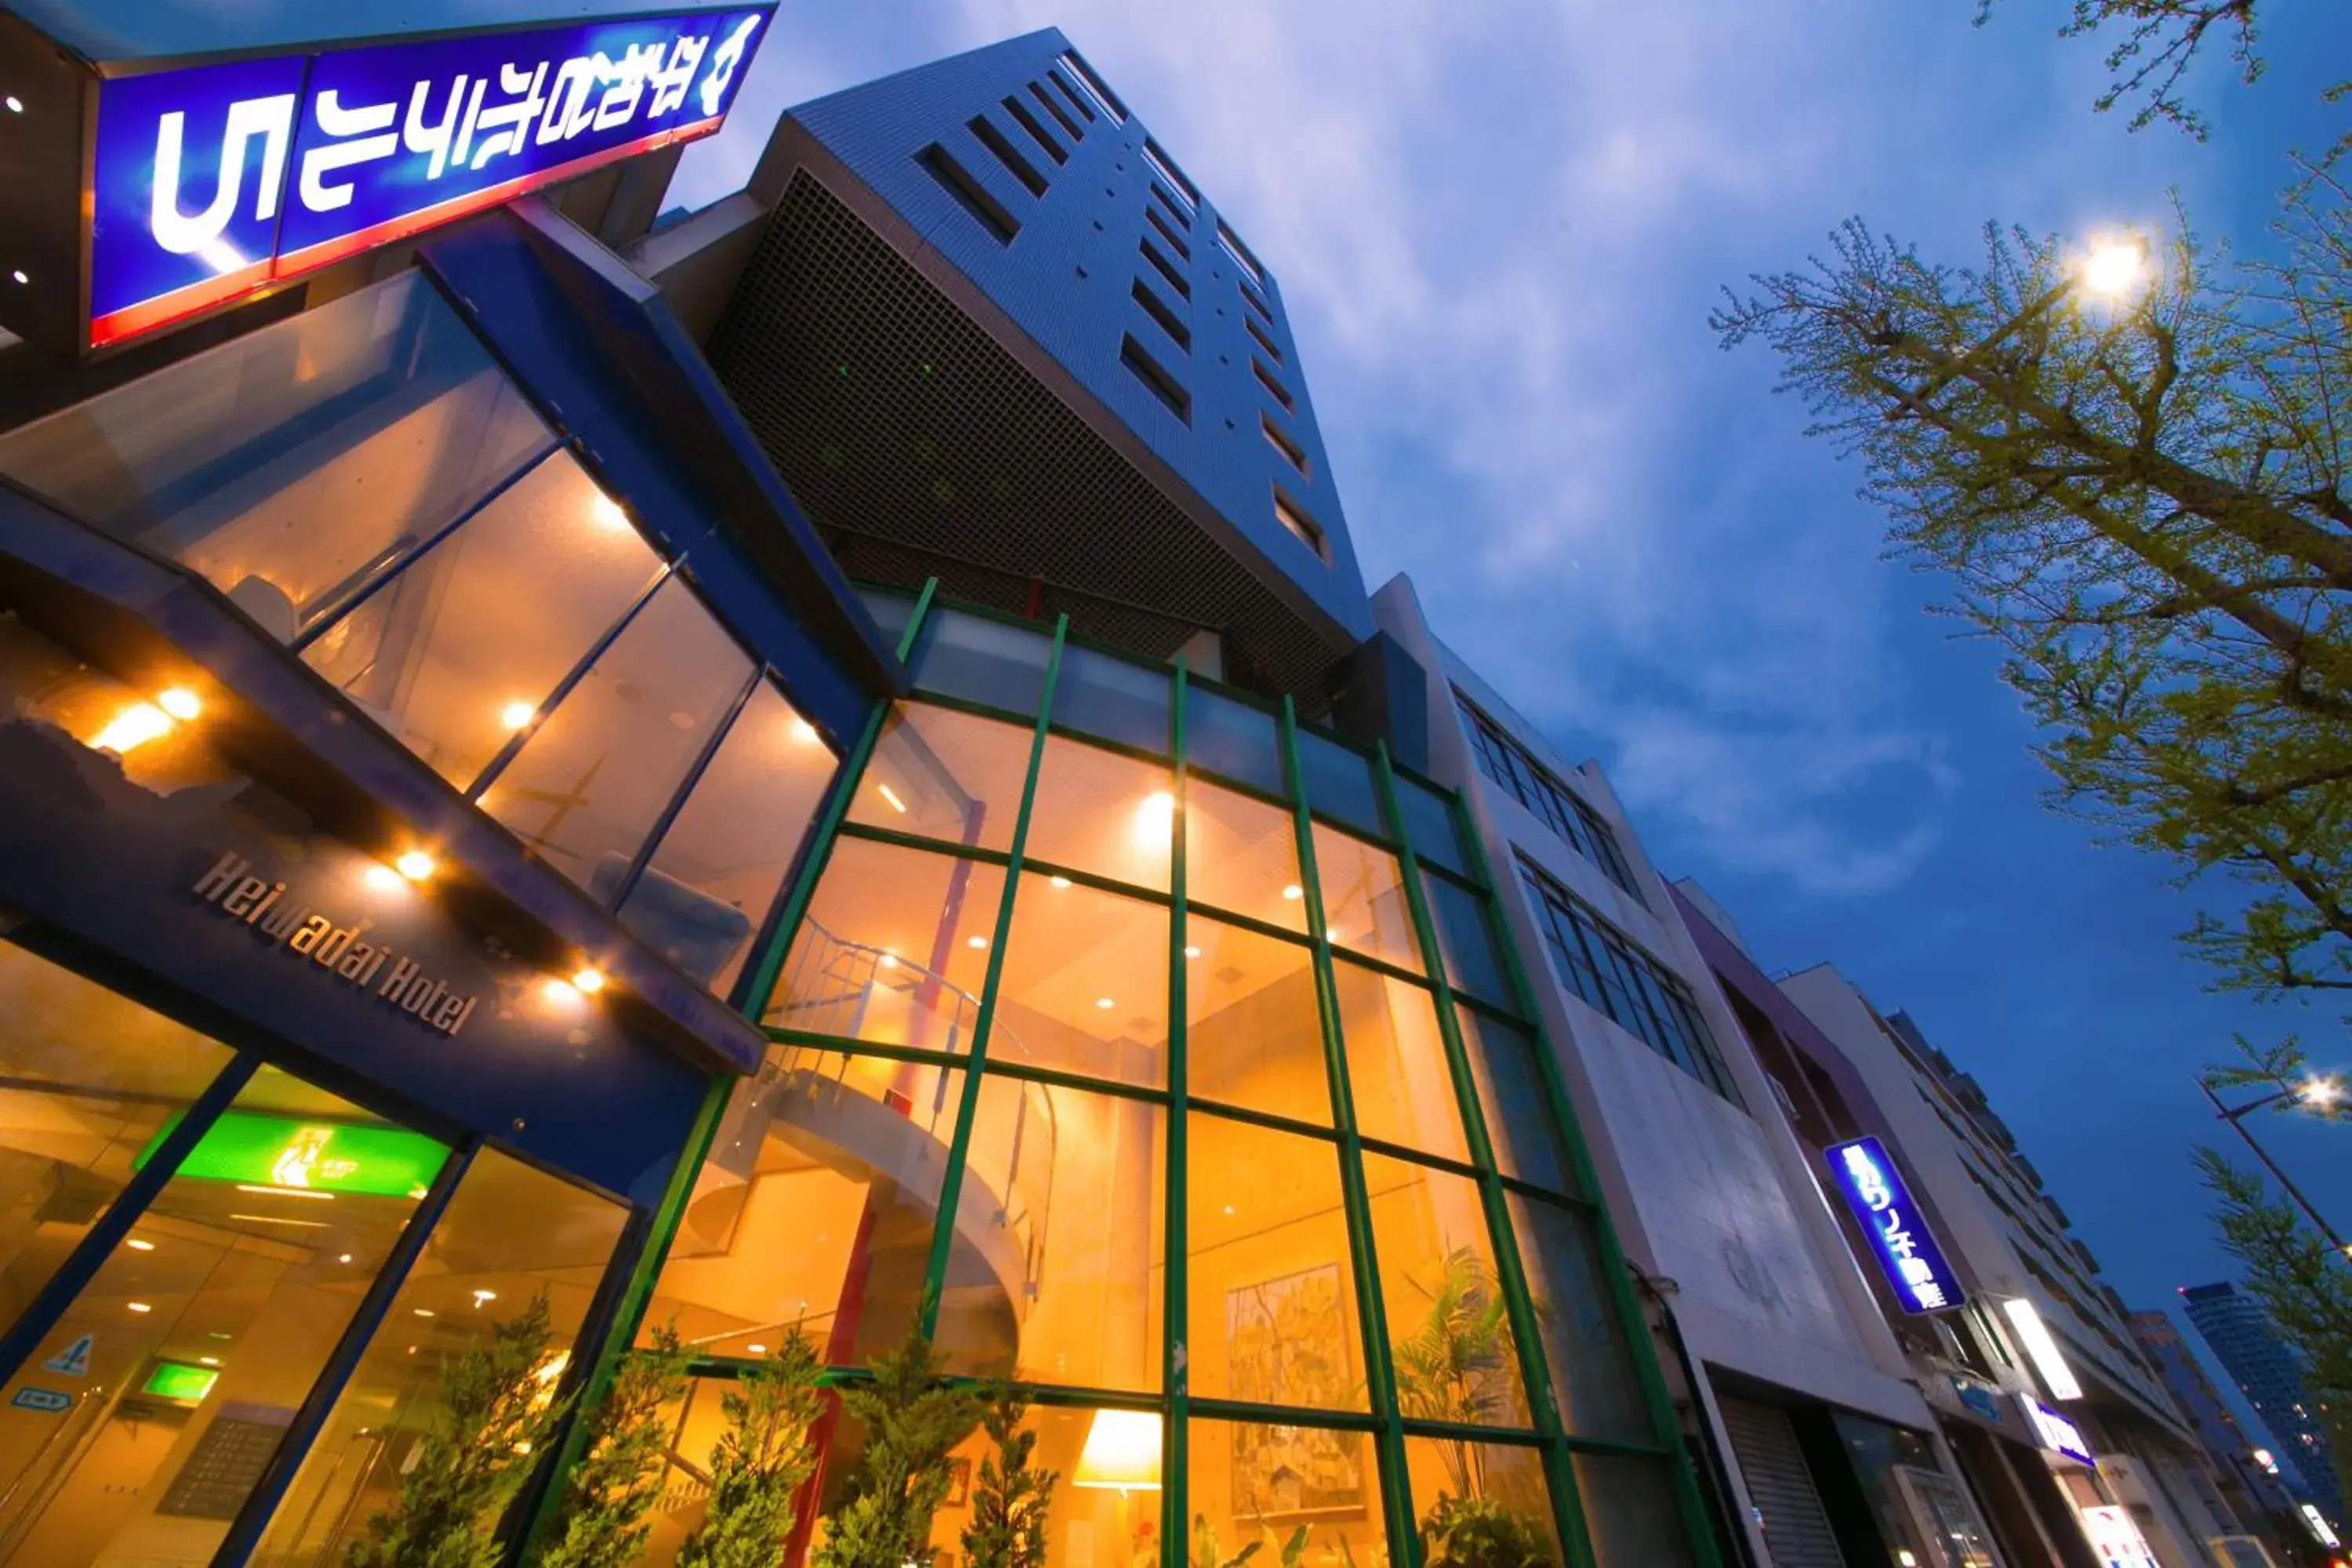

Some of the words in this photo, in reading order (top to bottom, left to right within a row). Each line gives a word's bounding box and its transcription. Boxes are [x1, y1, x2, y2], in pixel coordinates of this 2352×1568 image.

[152, 35, 709, 253] 平和台ホテル5
[194, 850, 391, 987] Heiwadai
[377, 955, 477, 1037] Hotel
